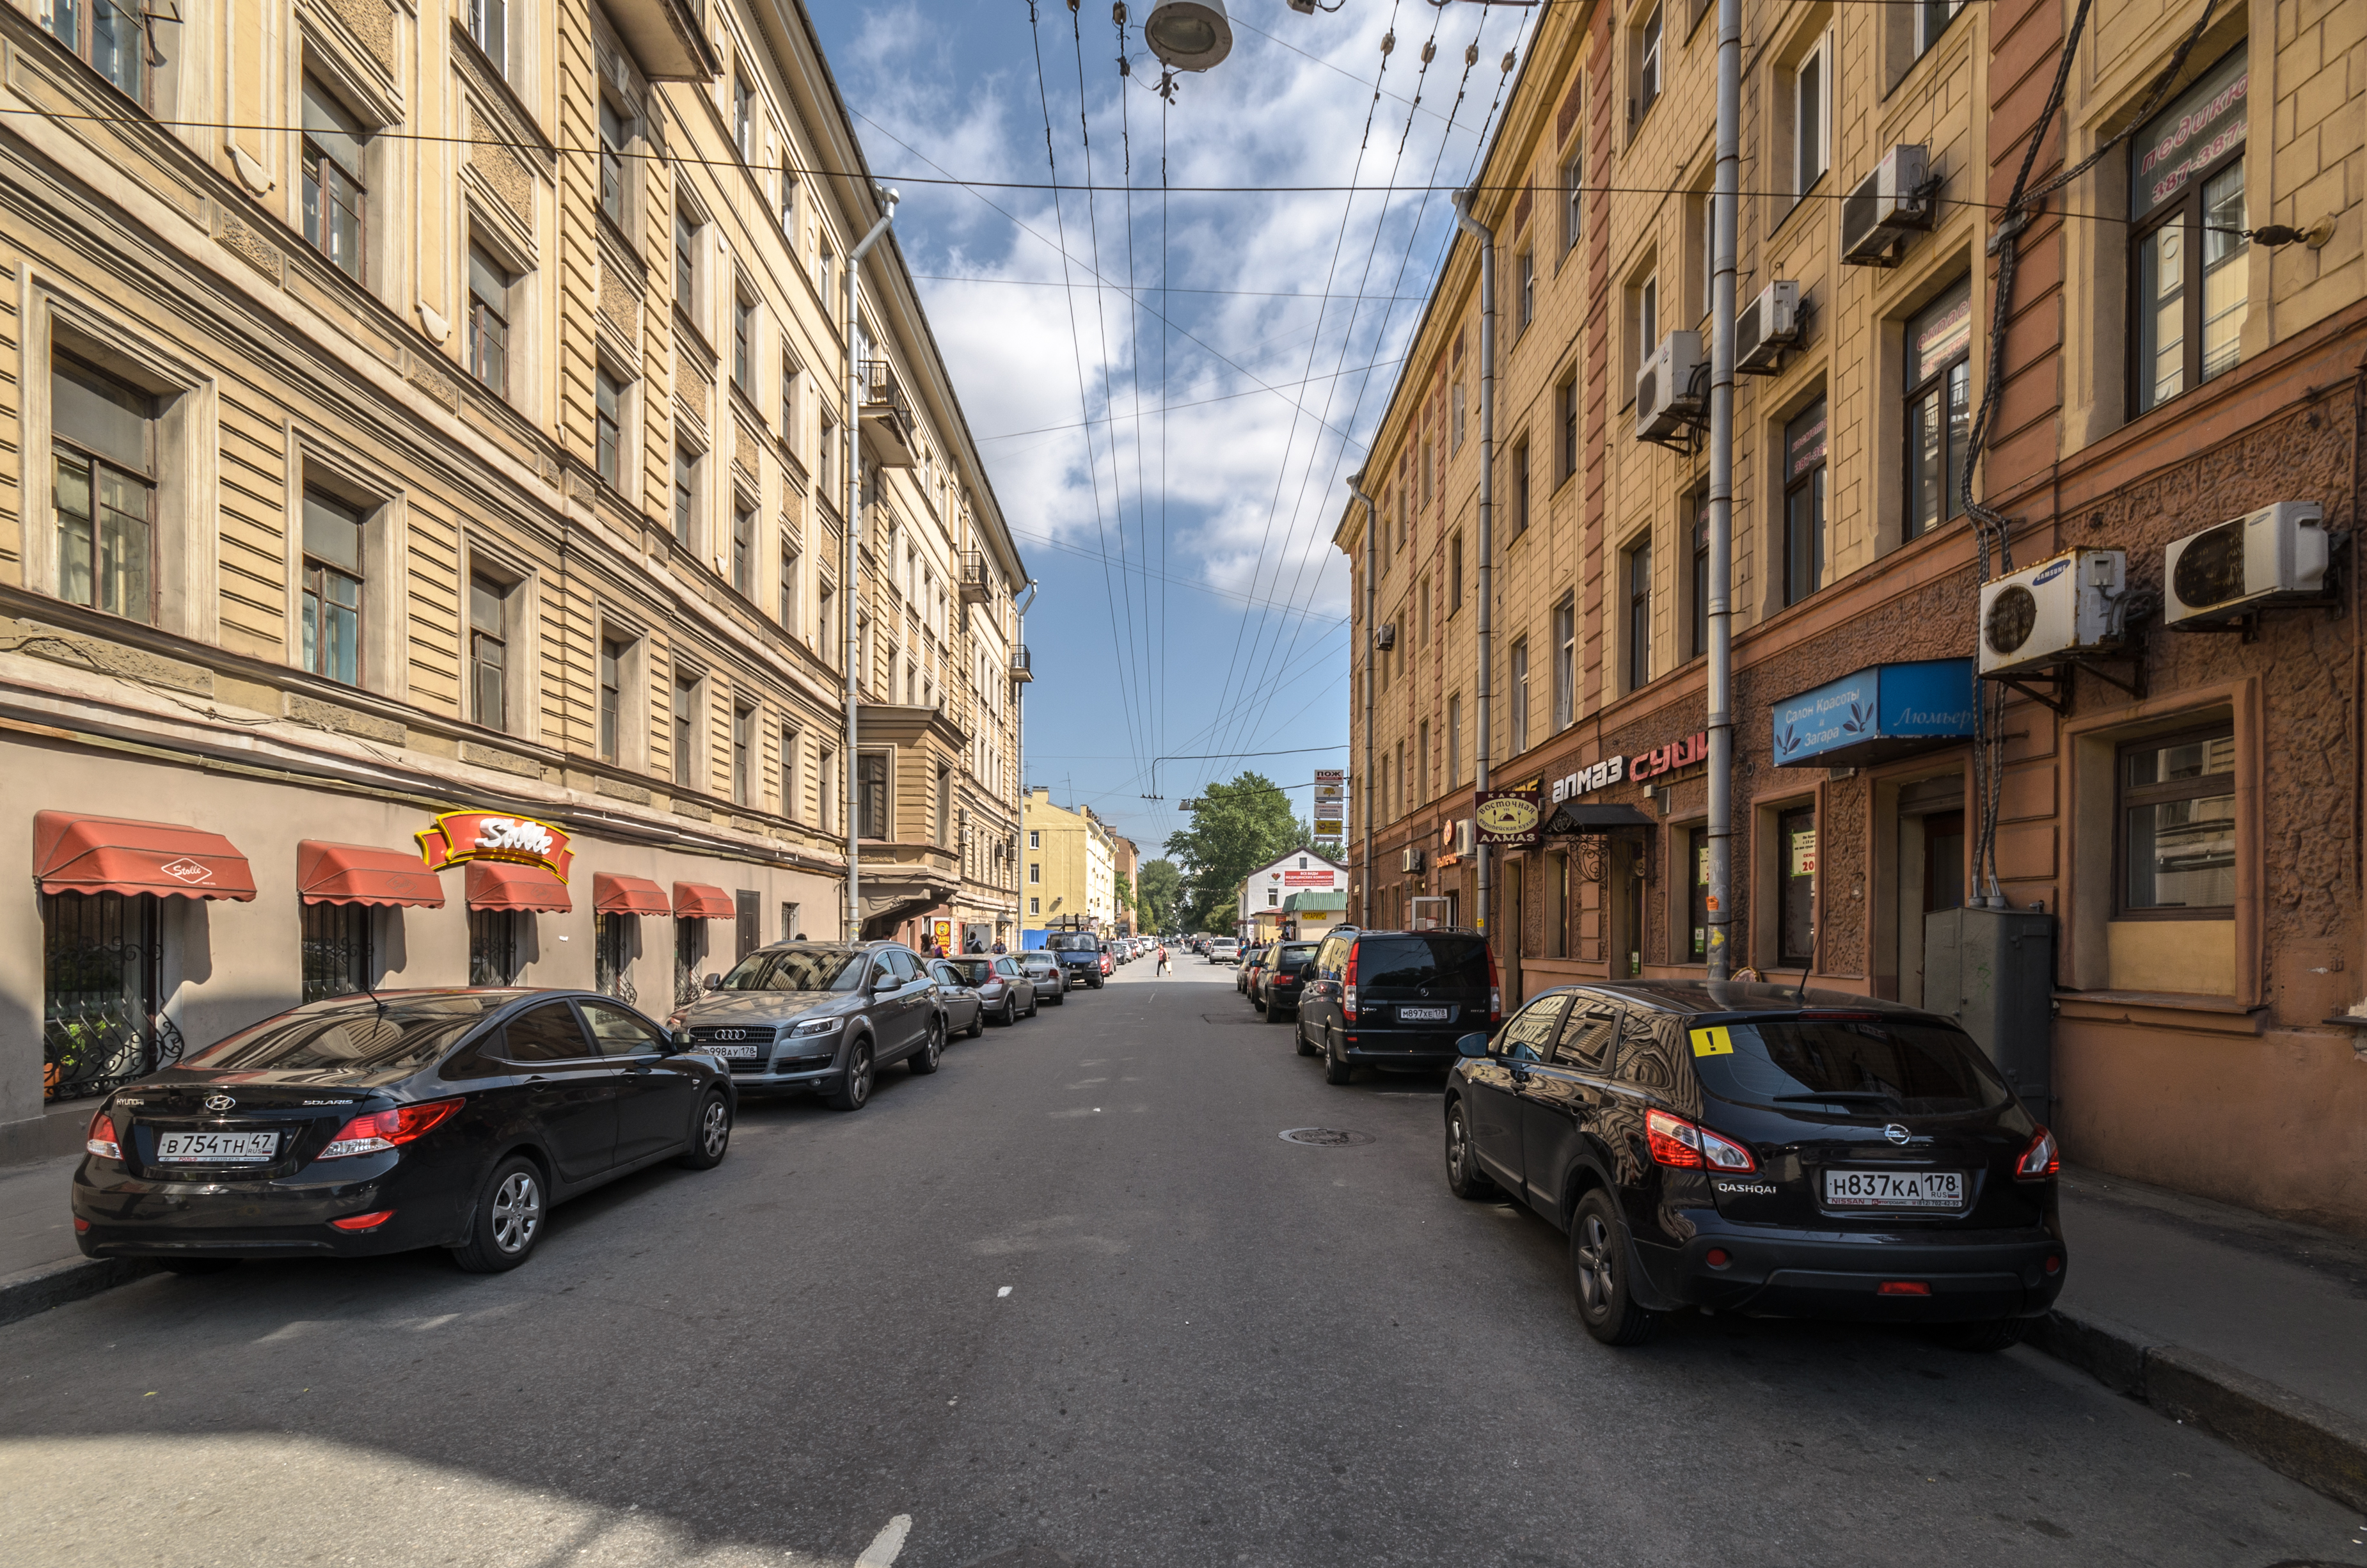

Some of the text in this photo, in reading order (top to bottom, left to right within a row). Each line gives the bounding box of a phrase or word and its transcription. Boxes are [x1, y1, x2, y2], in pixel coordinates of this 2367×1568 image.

[2036, 564, 2068, 582] SAMSUNG
[1785, 688, 1860, 724] Салон Красоты
[1819, 718, 1825, 727] и
[1894, 707, 1971, 729] Люмьер
[1804, 727, 1839, 747] Загара
[1479, 818, 1517, 831] европейская
[475, 818, 553, 855] Stolle
[1480, 833, 1535, 843] АЛМАЗ
[173, 865, 202, 876] Stolle
[1803, 860, 1814, 871] 20
[166, 1134, 271, 1153] В754ТН 47
[1718, 1183, 1777, 1194] QASHQAI
[1834, 1175, 1955, 1196] Н837КА 178
